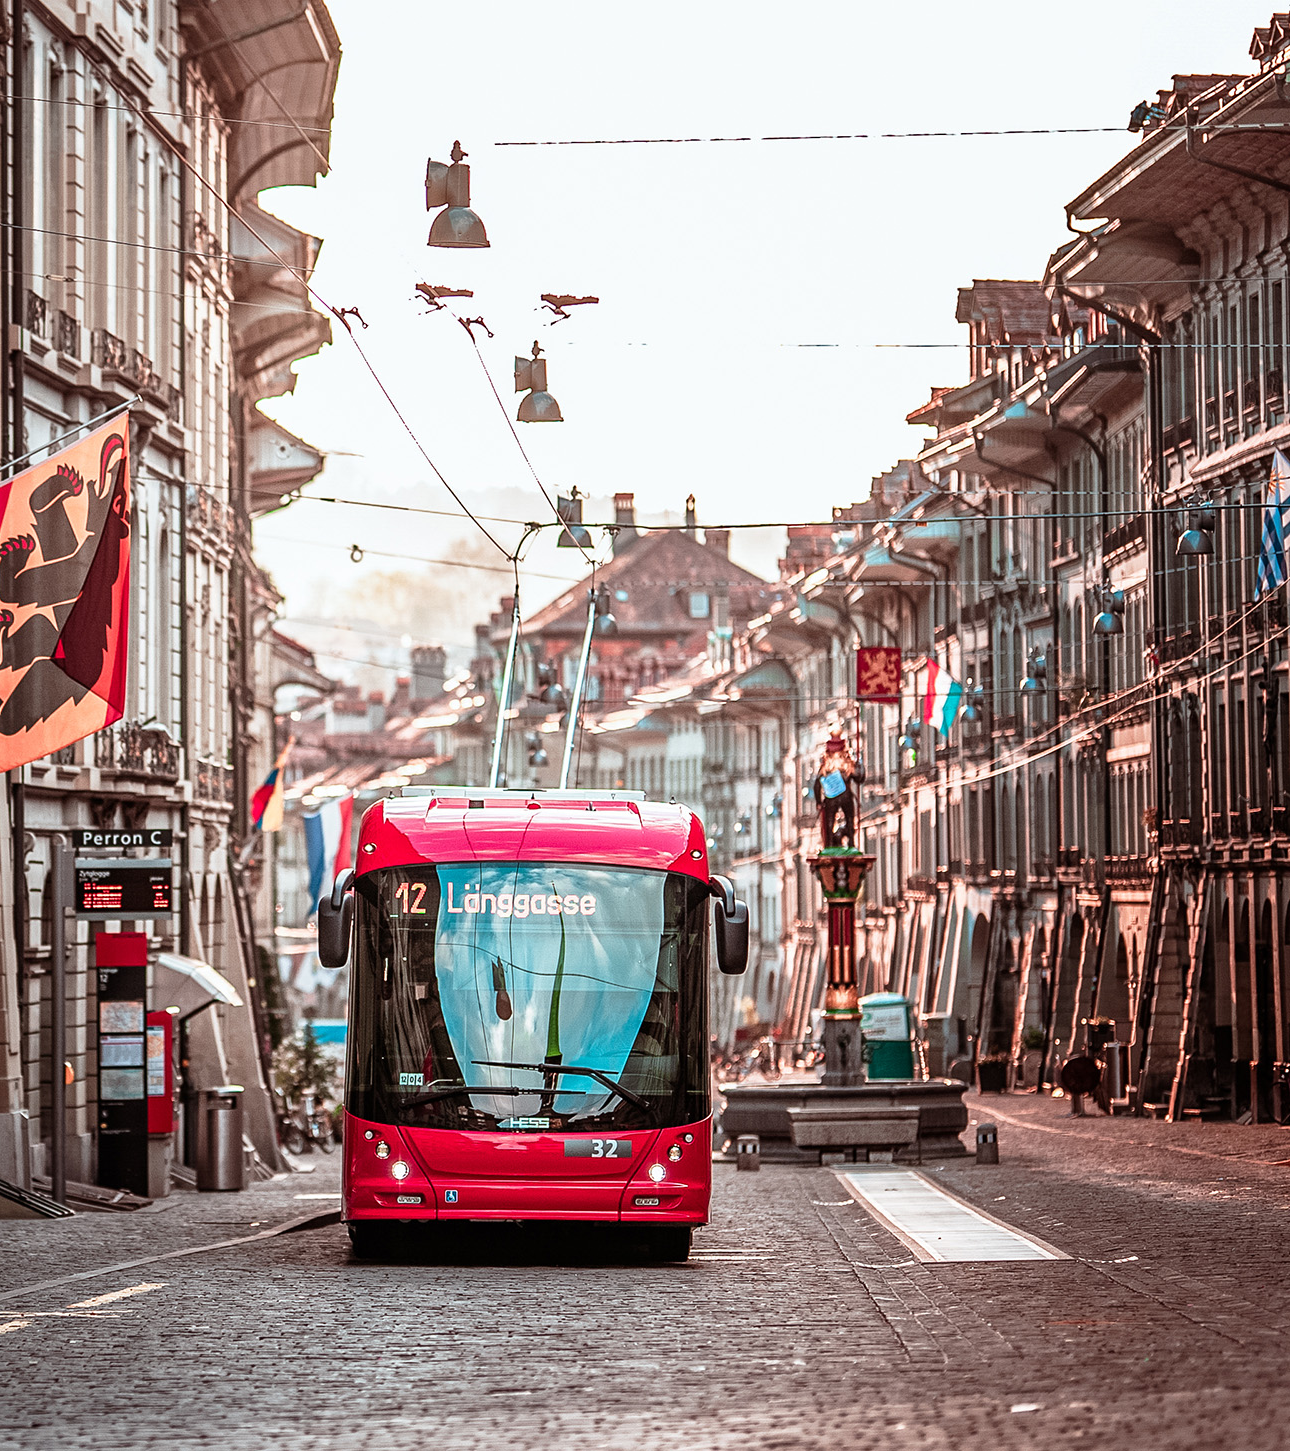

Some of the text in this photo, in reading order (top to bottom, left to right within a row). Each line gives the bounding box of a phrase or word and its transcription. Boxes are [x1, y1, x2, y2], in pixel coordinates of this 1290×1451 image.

[82, 830, 162, 846] Perron C
[394, 881, 597, 919] 12 Länggasse
[591, 1139, 618, 1158] 32
